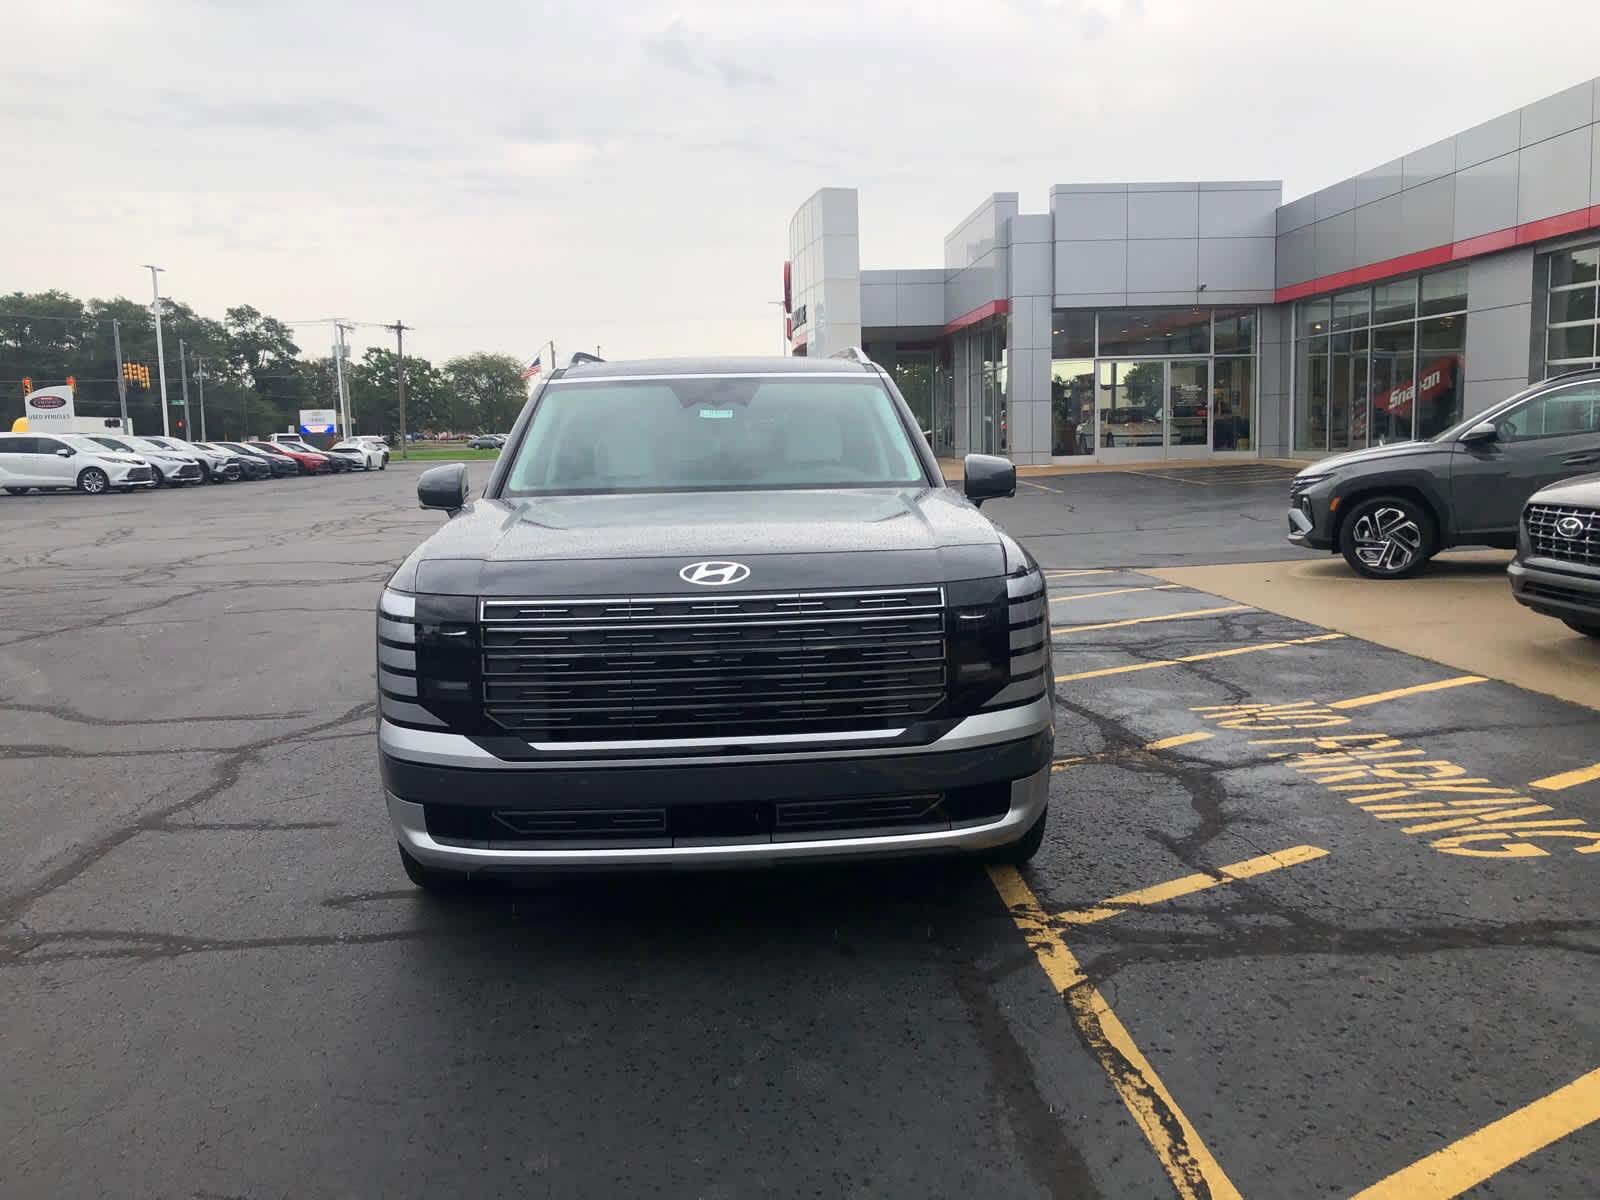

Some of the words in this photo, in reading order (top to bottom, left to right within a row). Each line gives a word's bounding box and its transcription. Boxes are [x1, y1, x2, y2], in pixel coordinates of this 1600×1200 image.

[1388, 370, 1441, 410] Sna-on
[1188, 701, 1352, 730] NO
[1247, 735, 1600, 858] PARKING
